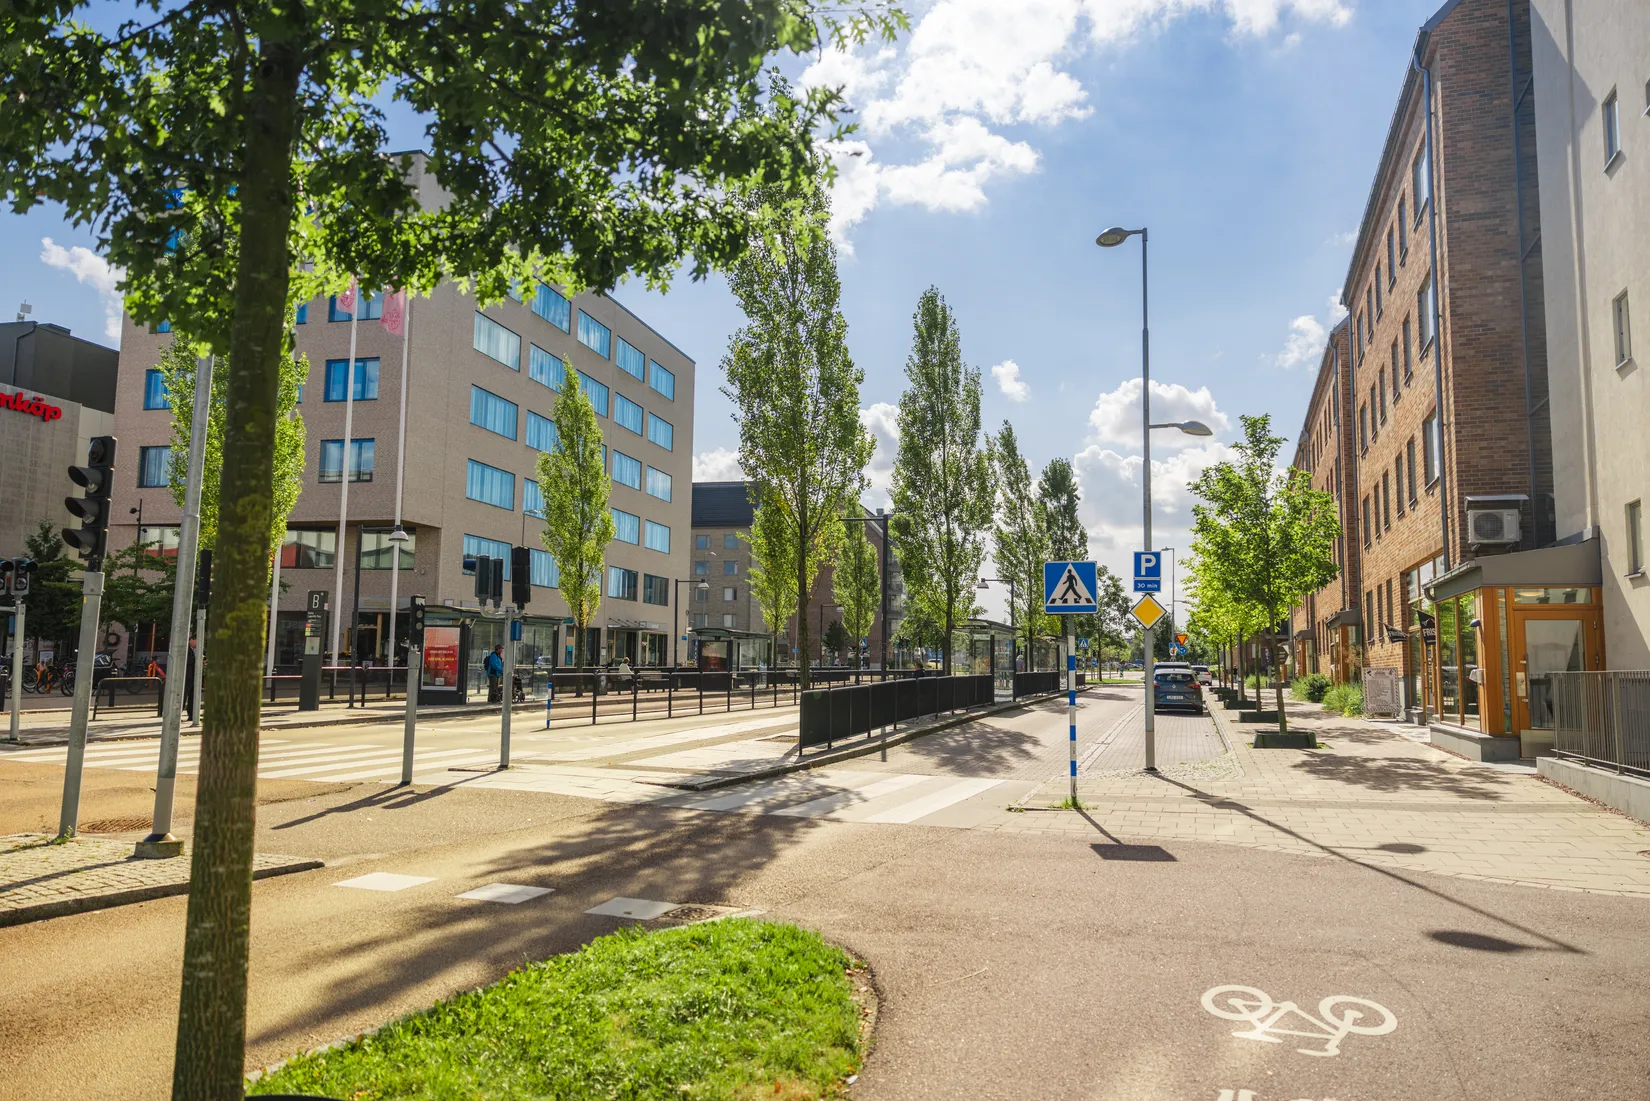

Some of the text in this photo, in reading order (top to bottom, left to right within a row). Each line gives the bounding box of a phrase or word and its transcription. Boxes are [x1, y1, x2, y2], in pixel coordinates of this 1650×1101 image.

[1141, 555, 1156, 576] P
[312, 594, 320, 609] B
[1422, 628, 1437, 637] FRIS
